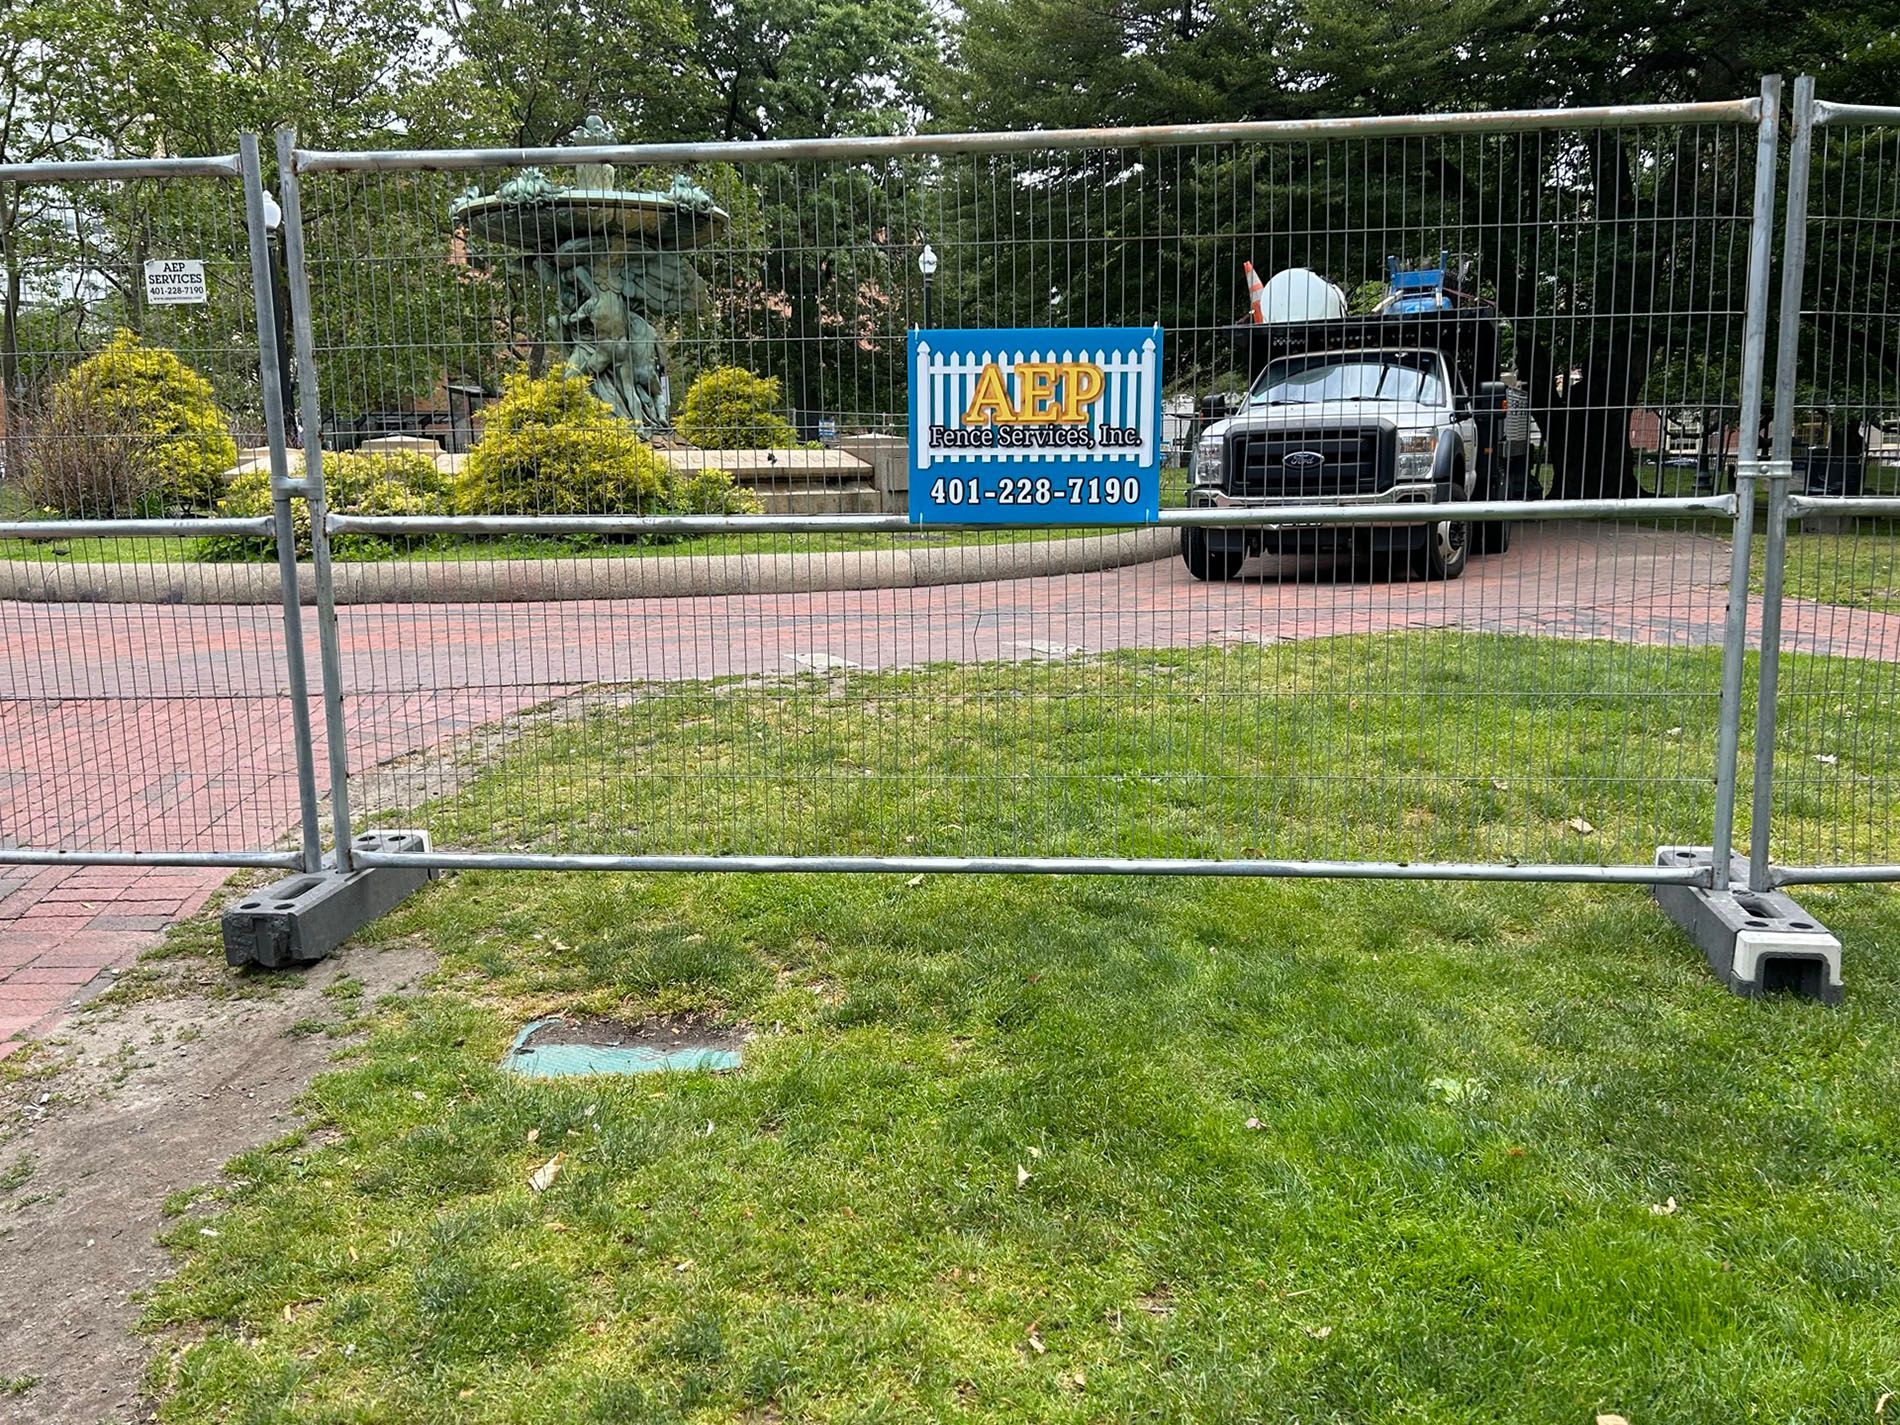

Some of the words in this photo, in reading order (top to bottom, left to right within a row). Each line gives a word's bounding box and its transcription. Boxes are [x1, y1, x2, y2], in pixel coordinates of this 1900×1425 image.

[163, 262, 186, 272] AEP
[148, 274, 202, 284] SERVICES
[150, 286, 204, 295] 401-228-7190
[963, 362, 1105, 426] AEP
[929, 425, 993, 449] Fence
[997, 425, 1096, 450] Services,
[1098, 423, 1143, 447] Inc.
[930, 477, 1140, 505] 401-228-7190
